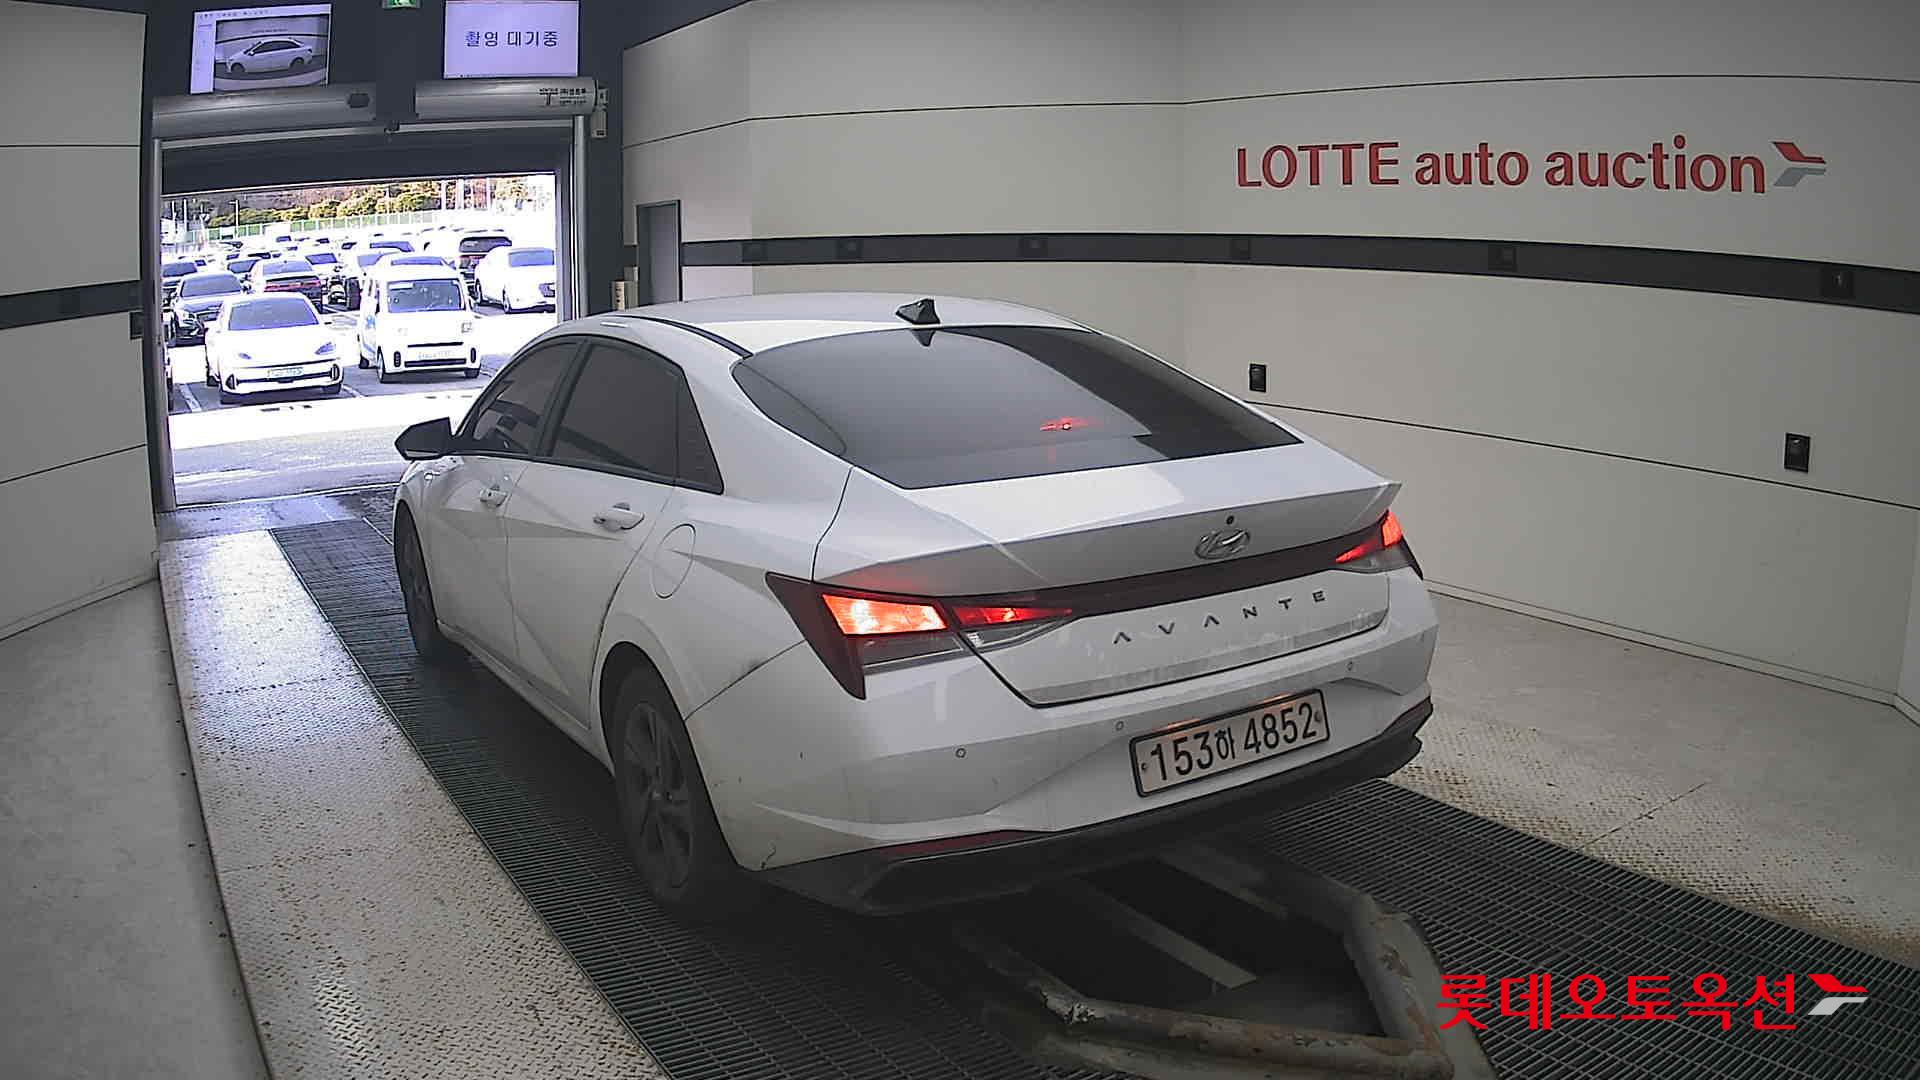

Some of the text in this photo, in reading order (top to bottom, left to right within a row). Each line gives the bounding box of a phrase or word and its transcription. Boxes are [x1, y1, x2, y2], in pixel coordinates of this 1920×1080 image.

[507, 31, 559, 47] 대기중
[1237, 134, 1765, 194] LOTTE auto auction
[1113, 590, 1326, 644] AVANTE
[1151, 702, 1317, 781] 153하 4852
